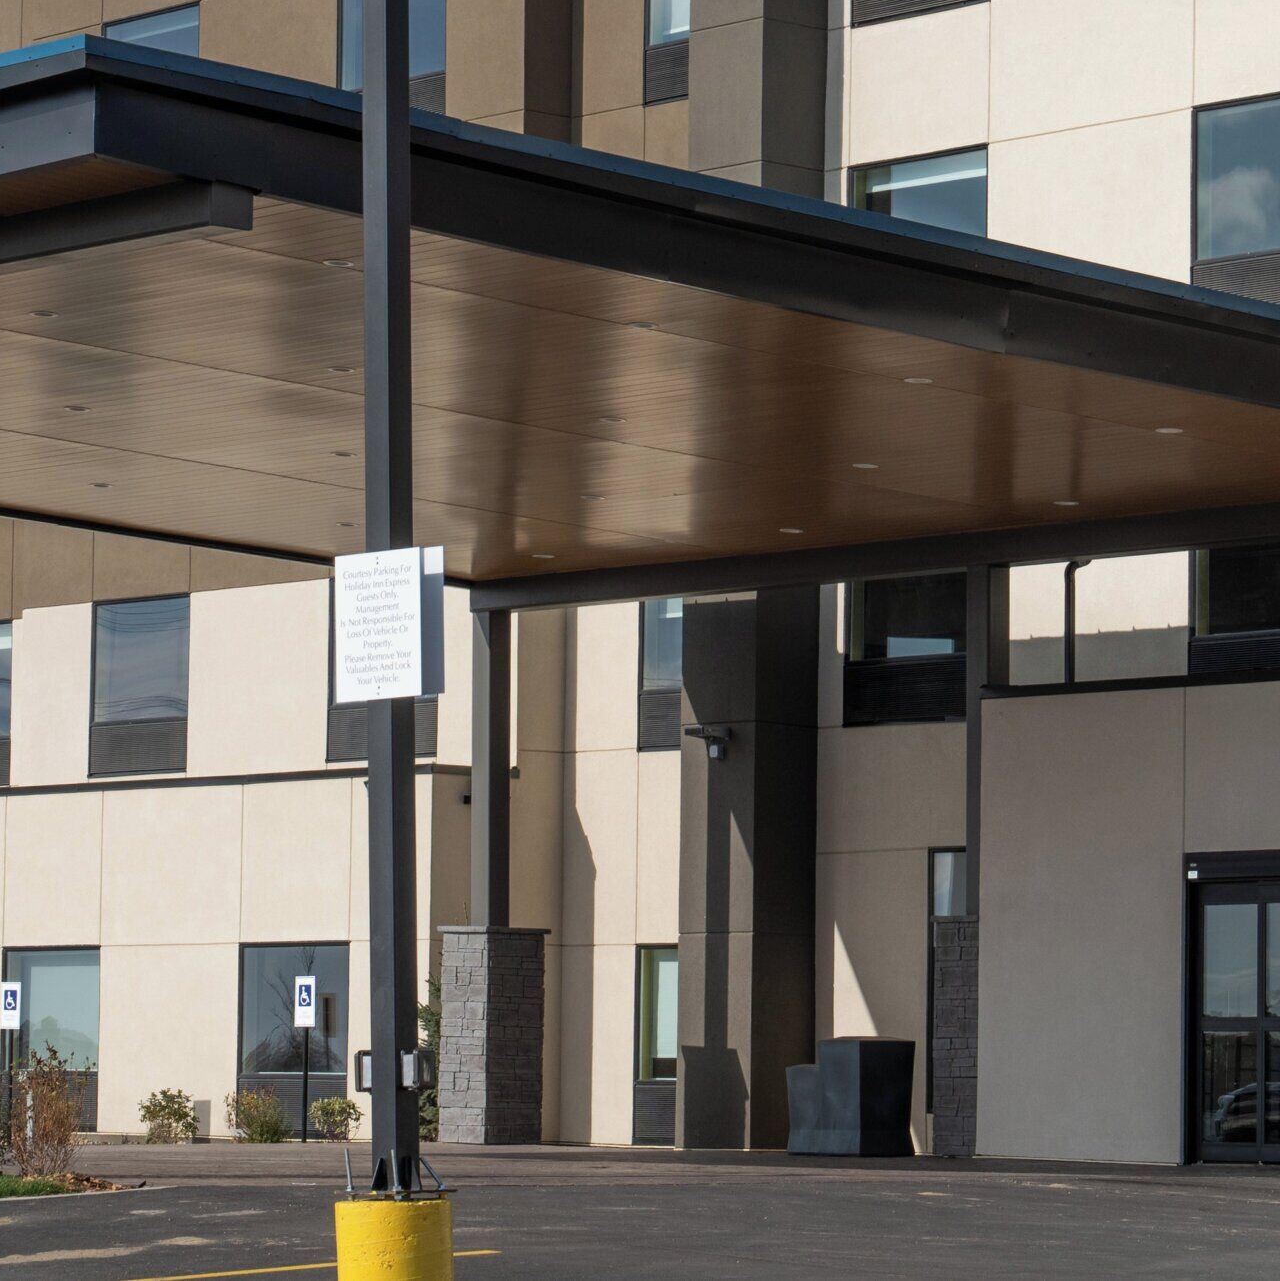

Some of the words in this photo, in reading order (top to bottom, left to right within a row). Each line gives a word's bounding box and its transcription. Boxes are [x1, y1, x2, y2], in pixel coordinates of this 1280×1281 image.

[342, 570, 373, 580] Courtesy
[373, 566, 400, 576] Parking
[400, 564, 412, 573] For
[344, 581, 372, 592] Holiday
[372, 580, 384, 588] Inn
[385, 578, 411, 588] Express
[356, 593, 379, 602] Guests
[355, 602, 400, 614] Management
[348, 618, 362, 627] Not
[362, 613, 403, 625] Responsible
[404, 612, 416, 621] For
[346, 630, 362, 639] Loss
[363, 628, 372, 637] Of
[373, 625, 399, 637] Vehicle
[399, 624, 409, 633] Or
[344, 654, 367, 664] Please
[367, 652, 395, 662] Remove
[395, 650, 412, 659] Your
[345, 663, 379, 675] Valuables
[379, 661, 394, 671] And
[394, 660, 412, 670] Lock
[356, 676, 373, 686] Your
